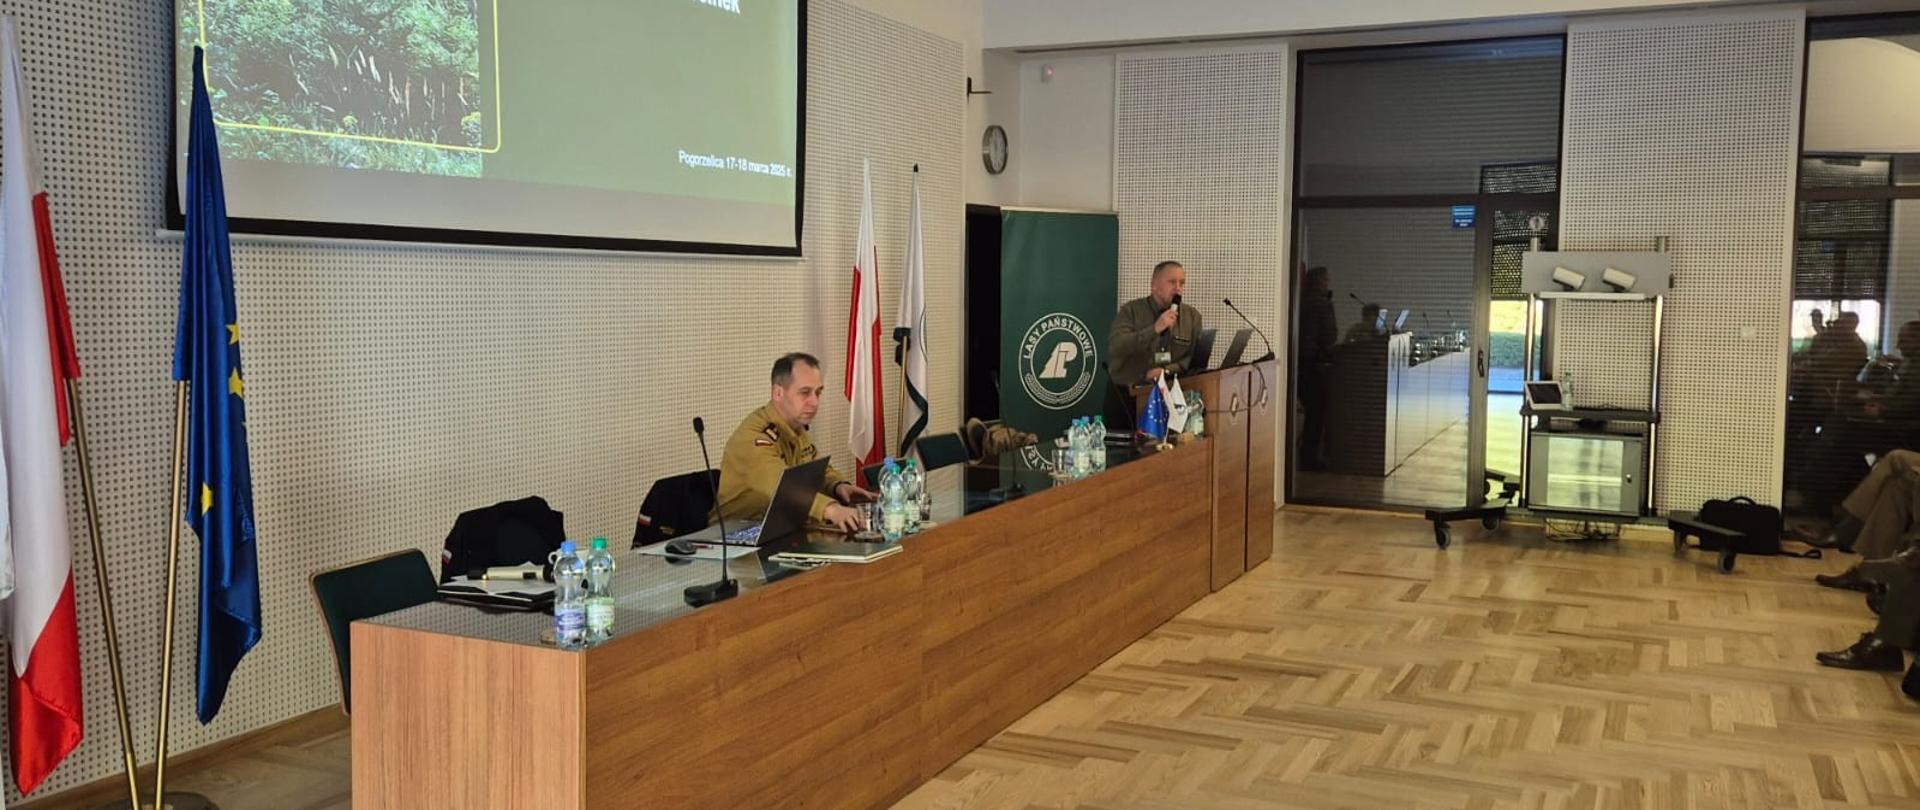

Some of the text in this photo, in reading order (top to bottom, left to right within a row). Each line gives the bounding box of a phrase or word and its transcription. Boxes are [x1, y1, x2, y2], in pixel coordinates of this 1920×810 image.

[678, 150, 725, 168] Pogorzelica
[726, 157, 748, 171] 17-18
[748, 162, 770, 174] marca
[770, 163, 786, 177] 2025
[1023, 316, 1094, 360] LASY PAŃSTWOWE
